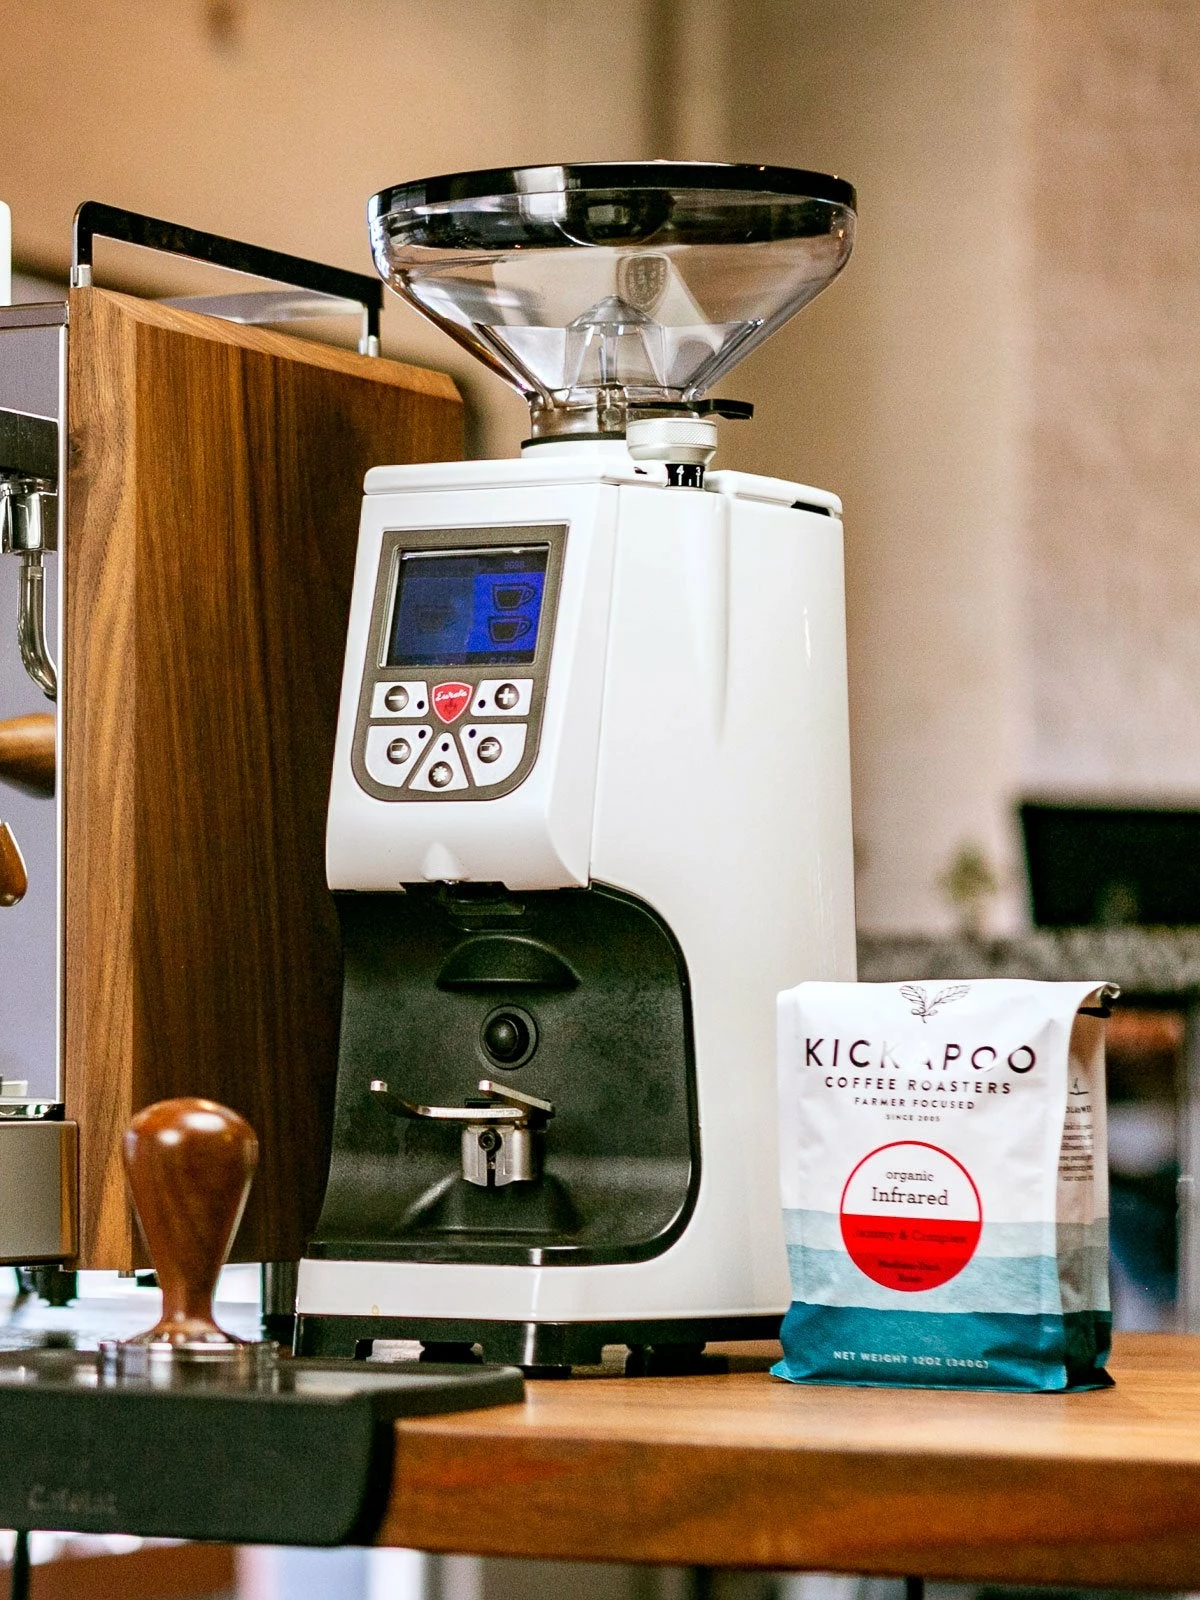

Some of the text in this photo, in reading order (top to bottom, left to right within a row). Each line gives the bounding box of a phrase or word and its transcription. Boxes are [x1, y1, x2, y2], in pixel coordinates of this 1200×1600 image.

[676, 465, 701, 476] 4 3
[825, 1077, 1011, 1094] COFFEE ROASTERS
[854, 1097, 975, 1110] FARMER FOCUSED
[886, 1113, 914, 1121] SINCE
[886, 1170, 934, 1182] organic
[872, 1186, 948, 1206] Infrared
[833, 1351, 856, 1360] NET
[860, 1352, 909, 1364] WEIGHT
